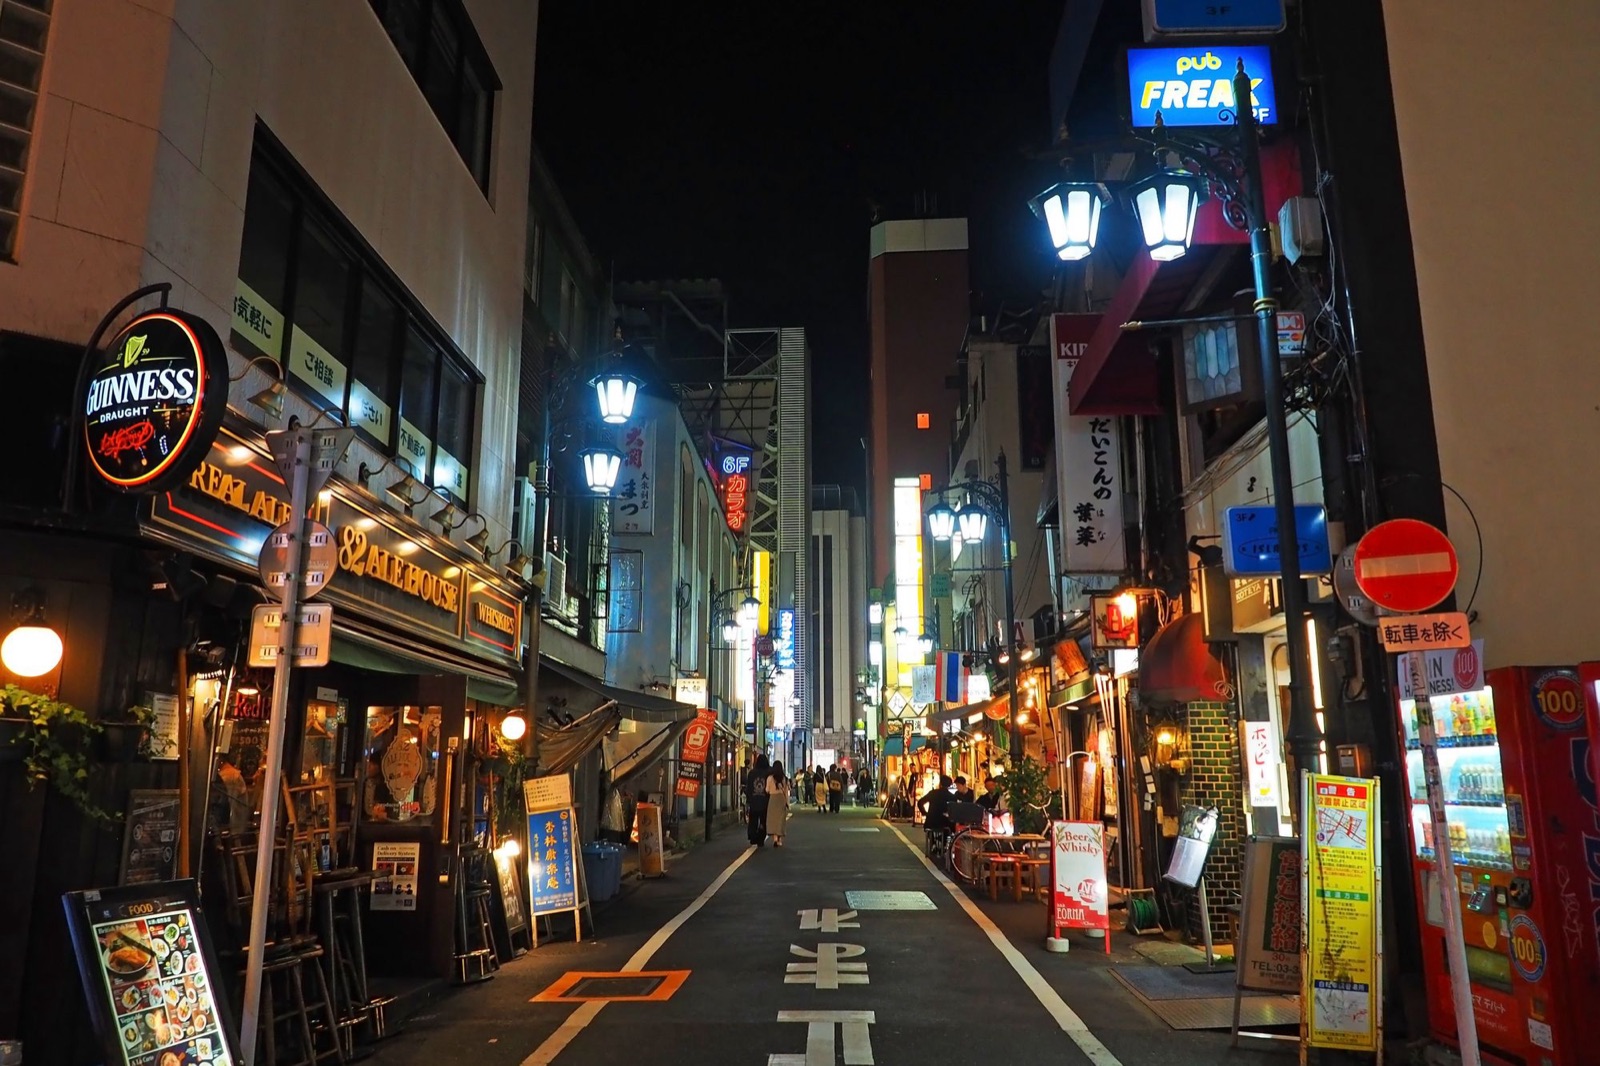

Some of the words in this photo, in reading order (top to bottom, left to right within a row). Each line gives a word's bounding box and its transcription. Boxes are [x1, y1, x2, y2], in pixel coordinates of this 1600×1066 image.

[1176, 52, 1222, 76] pub
[1060, 342, 1088, 357] KIR
[304, 351, 334, 388] ご相談
[86, 368, 195, 416] GUINNESS
[100, 406, 149, 424] DRAUGHT
[361, 399, 383, 427] ださい
[400, 428, 426, 457] 不動産の
[722, 456, 750, 474] 6F
[1089, 416, 1113, 500] だいこんの
[189, 461, 250, 512] REAL
[619, 478, 639, 516] まつ
[727, 474, 747, 529] カラオ
[338, 524, 368, 577] 82
[366, 544, 405, 592] ALE
[402, 563, 459, 614] HOUSE
[476, 600, 516, 636] WHISKIES
[1384, 622, 1463, 644] 転車を除く
[688, 726, 707, 746] 占
[1251, 728, 1270, 779] ホッピー
[1059, 841, 1100, 857] Whisky
[1064, 831, 1089, 842] Beer
[128, 903, 154, 916] FOOD
